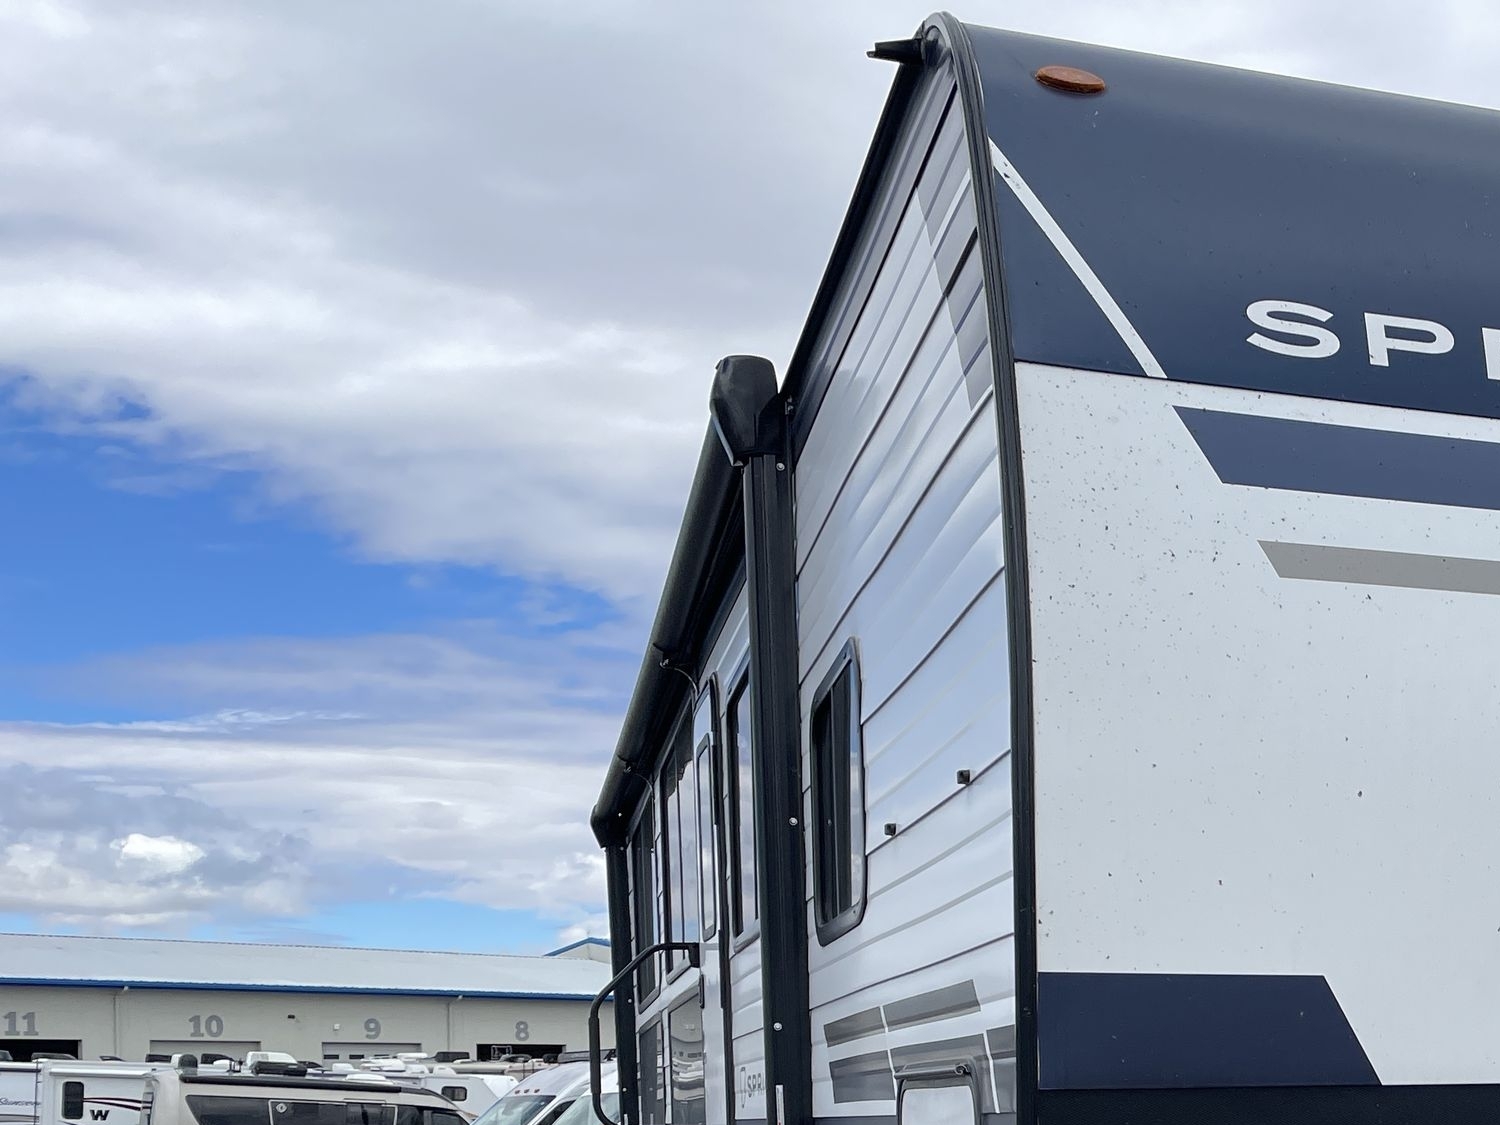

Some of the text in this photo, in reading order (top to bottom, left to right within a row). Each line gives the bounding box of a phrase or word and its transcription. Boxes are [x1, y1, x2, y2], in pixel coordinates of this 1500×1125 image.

[3, 1011, 39, 1036] 11
[188, 1014, 224, 1038] 10
[364, 1018, 381, 1039] 9
[515, 1021, 529, 1041] 8
[90, 1109, 110, 1121] W
